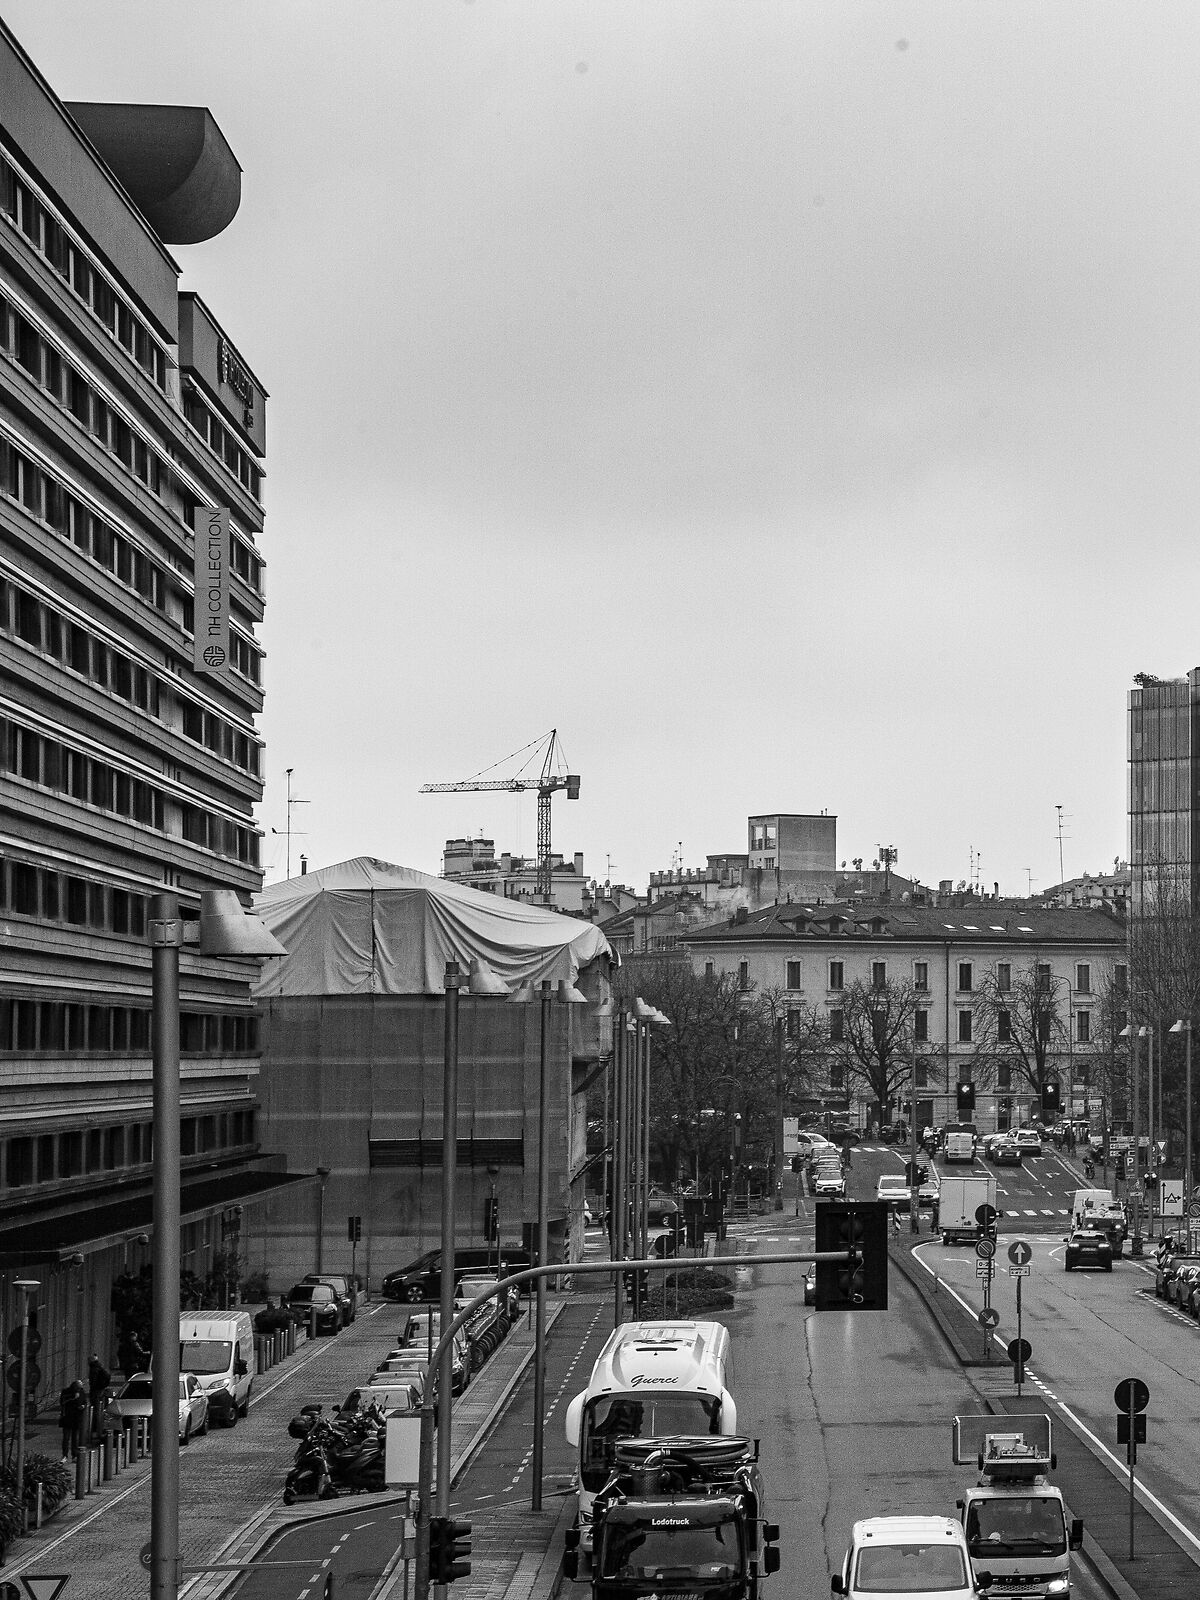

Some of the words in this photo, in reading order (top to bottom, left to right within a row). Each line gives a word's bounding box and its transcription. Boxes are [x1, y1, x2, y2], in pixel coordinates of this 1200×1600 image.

[208, 512, 222, 612] COLLECTION
[630, 1374, 679, 1388] Guerci
[651, 1517, 690, 1526] Lodotruck
